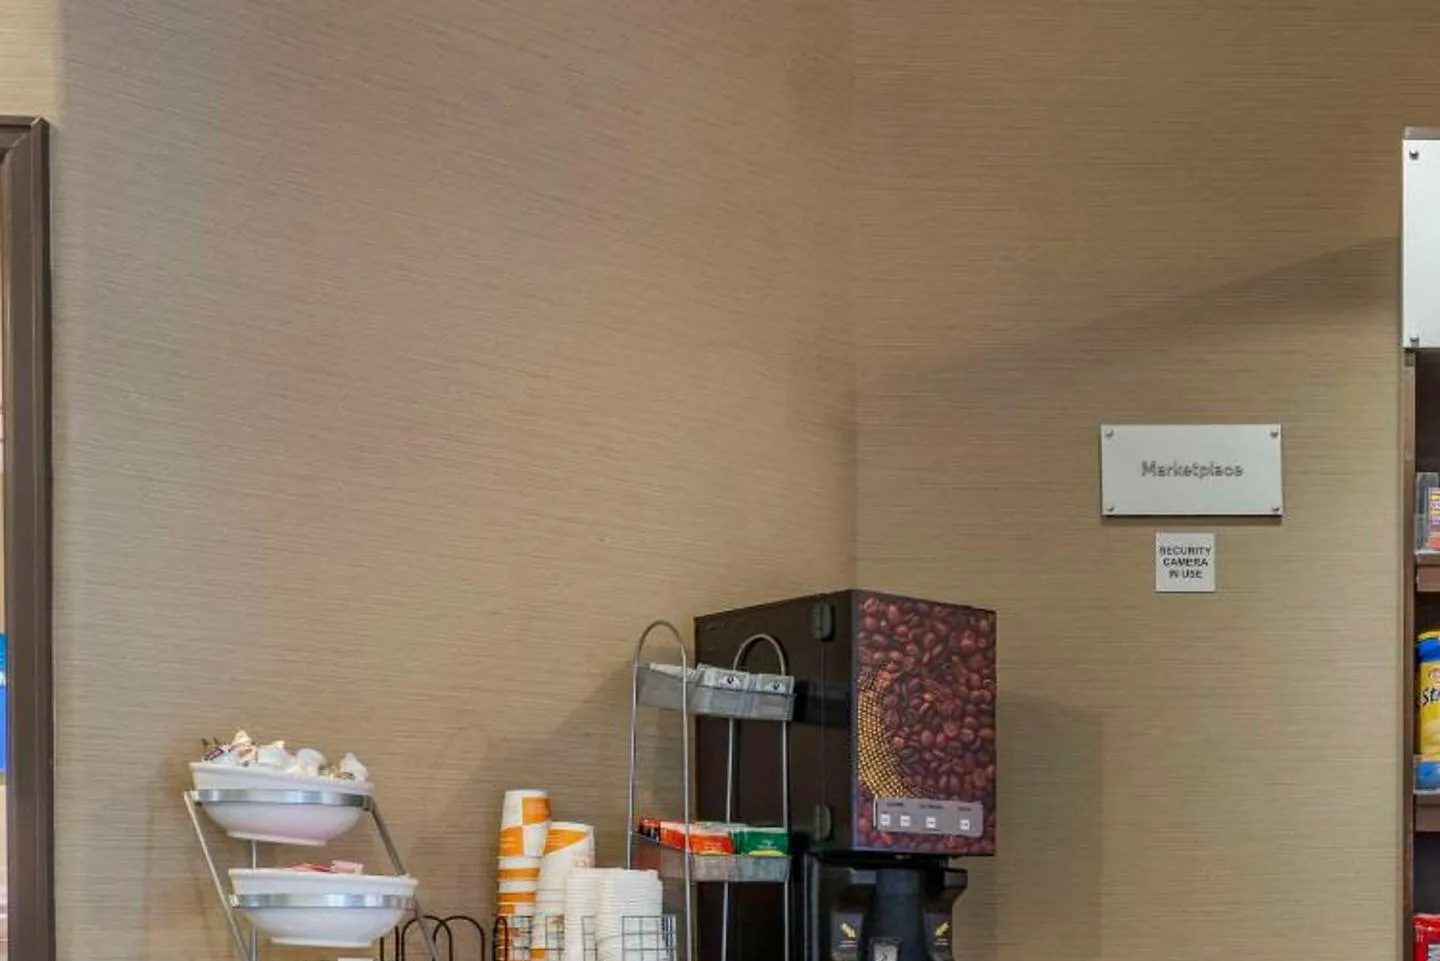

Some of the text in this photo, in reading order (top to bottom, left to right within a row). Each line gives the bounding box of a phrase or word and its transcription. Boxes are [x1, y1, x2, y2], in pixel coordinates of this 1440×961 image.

[1141, 460, 1243, 478] Marketplace
[1160, 546, 1212, 556] SECURITY
[1163, 557, 1209, 567] CAMERA
[1169, 570, 1203, 579] IN USE
